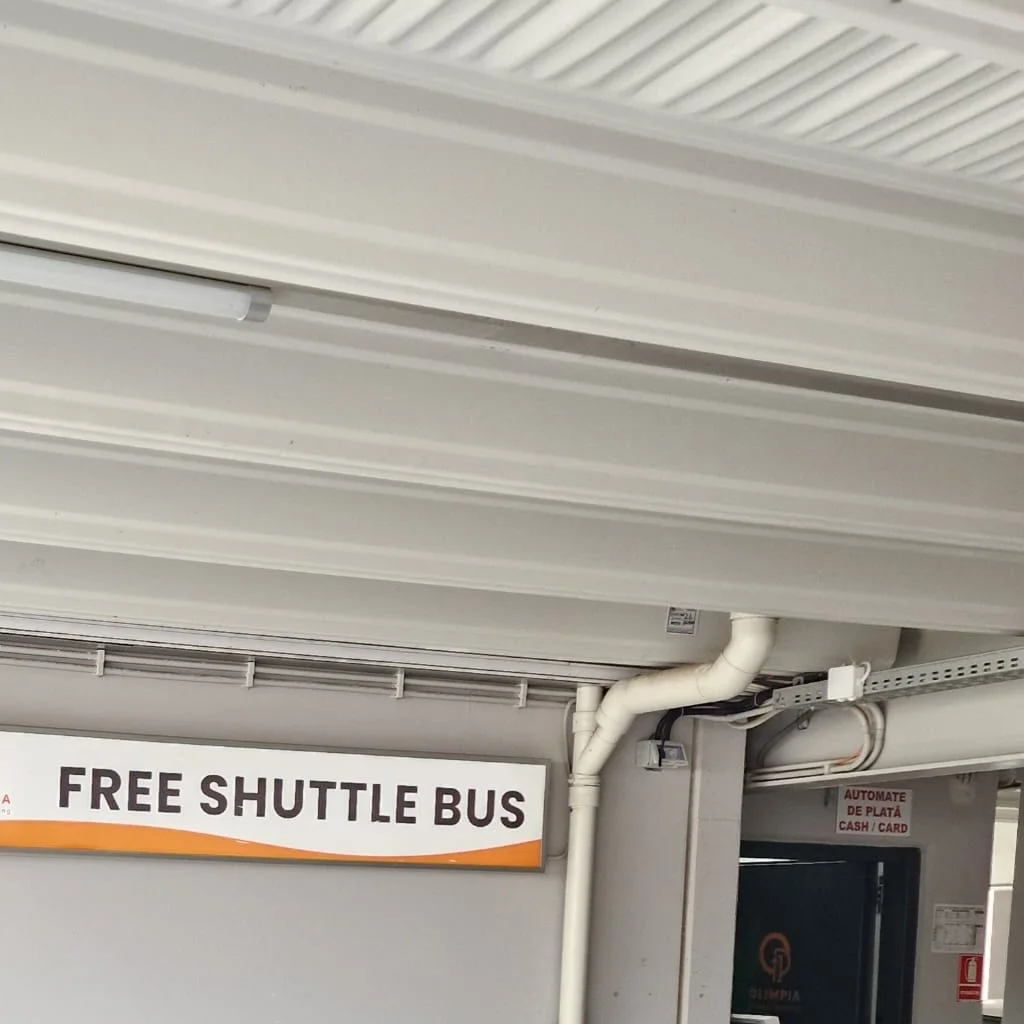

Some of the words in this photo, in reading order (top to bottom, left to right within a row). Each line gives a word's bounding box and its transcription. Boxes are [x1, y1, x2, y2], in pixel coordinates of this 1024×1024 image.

[58, 766, 183, 814] FREE
[199, 774, 418, 825] SHUTTLE
[433, 786, 526, 829] BUS
[844, 788, 907, 802] AUTOMATE
[847, 805, 862, 816] DE
[865, 804, 902, 818] PLATĂ
[839, 820, 869, 832] CASH
[878, 822, 908, 833] CARD
